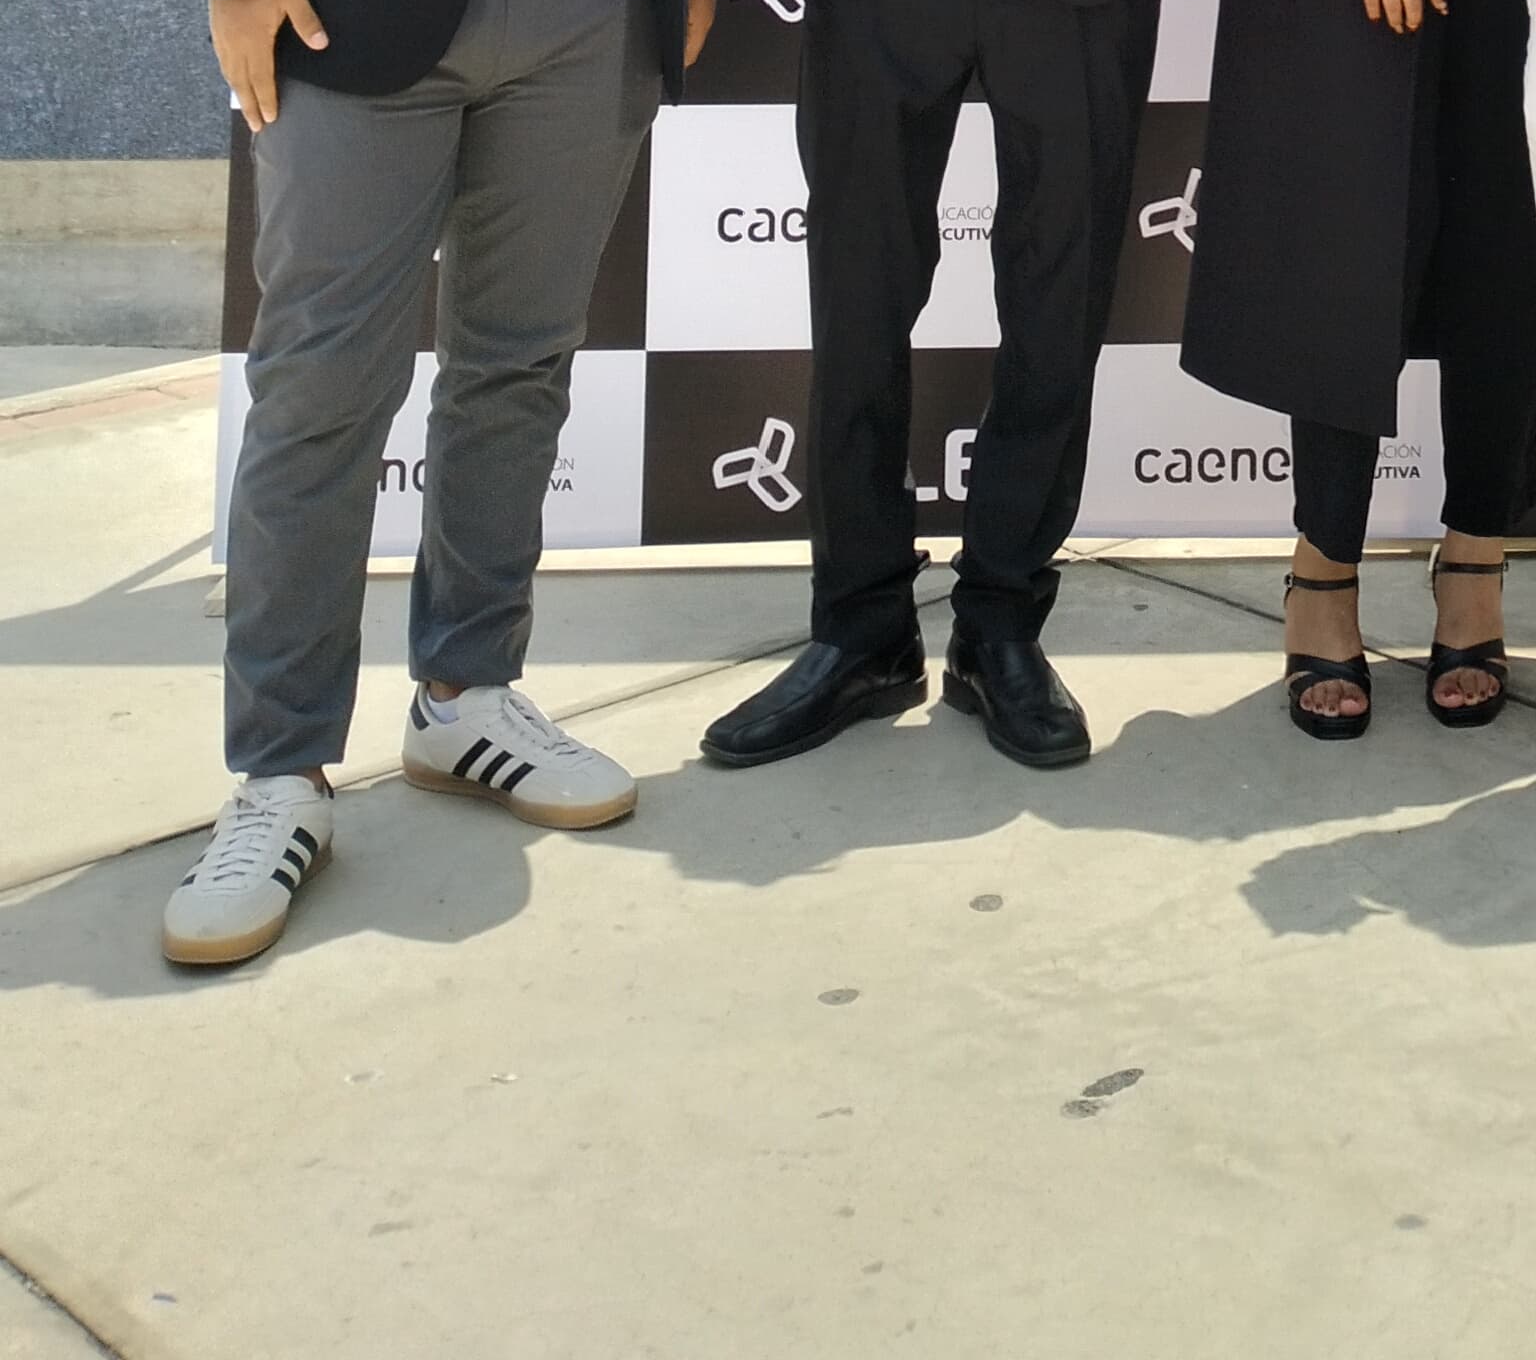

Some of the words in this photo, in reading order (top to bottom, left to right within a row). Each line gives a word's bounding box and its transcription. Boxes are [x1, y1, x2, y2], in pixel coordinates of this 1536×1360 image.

[718, 207, 807, 242] cae
[942, 227, 992, 241] CUTIV
[1134, 446, 1291, 483] caene
